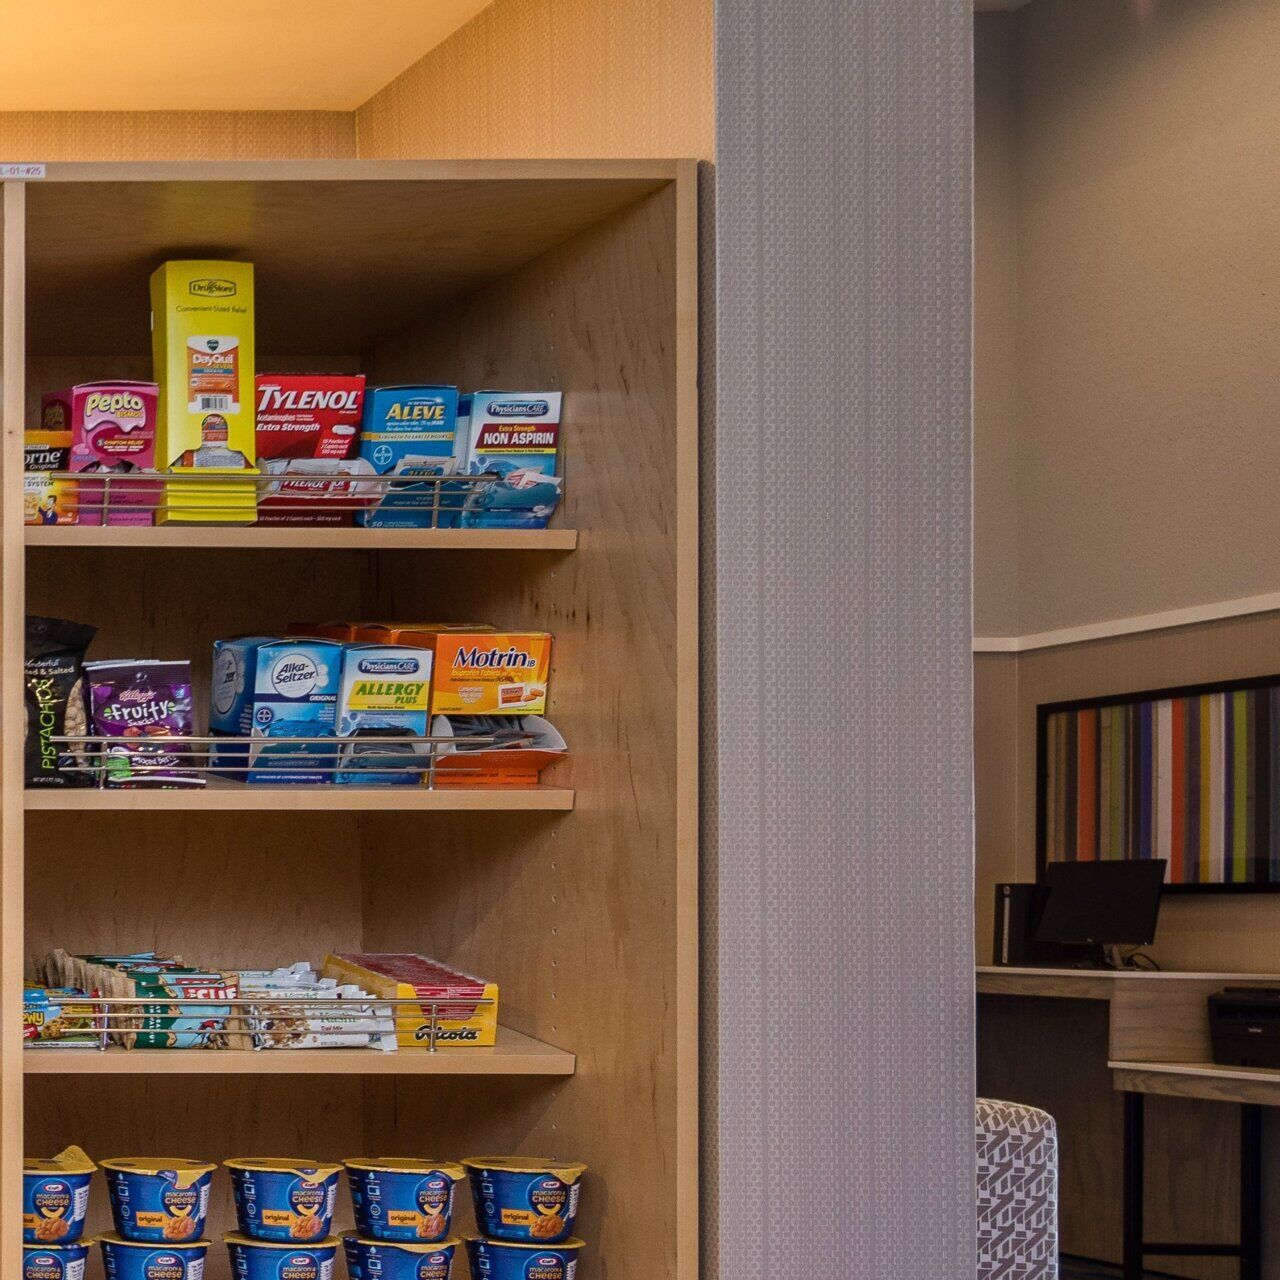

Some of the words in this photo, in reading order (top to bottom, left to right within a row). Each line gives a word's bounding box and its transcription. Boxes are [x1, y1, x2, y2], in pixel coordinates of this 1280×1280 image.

[192, 354, 234, 366] DayQuil
[86, 391, 144, 417] pepto
[258, 386, 361, 411] TYLENOL
[385, 404, 446, 420] ALEVE
[491, 402, 546, 415] PhysiciansCARE
[256, 423, 280, 431] Extra
[281, 422, 320, 432] Strength
[483, 433, 509, 445] NON
[511, 432, 554, 445] ASPIRIN
[29, 463, 59, 471] Original
[453, 646, 528, 668] Motrin
[527, 659, 536, 667] IB
[48, 667, 75, 675] Salted
[278, 662, 310, 673] Alka-
[361, 661, 417, 672] PhysiciansCARE
[275, 670, 315, 685] Seltzer
[356, 683, 424, 695] ALLERGY
[395, 696, 417, 704] PLUS
[111, 702, 169, 721] fruity
[39, 679, 56, 769] PISTACHIOS
[127, 717, 155, 727] Snacks
